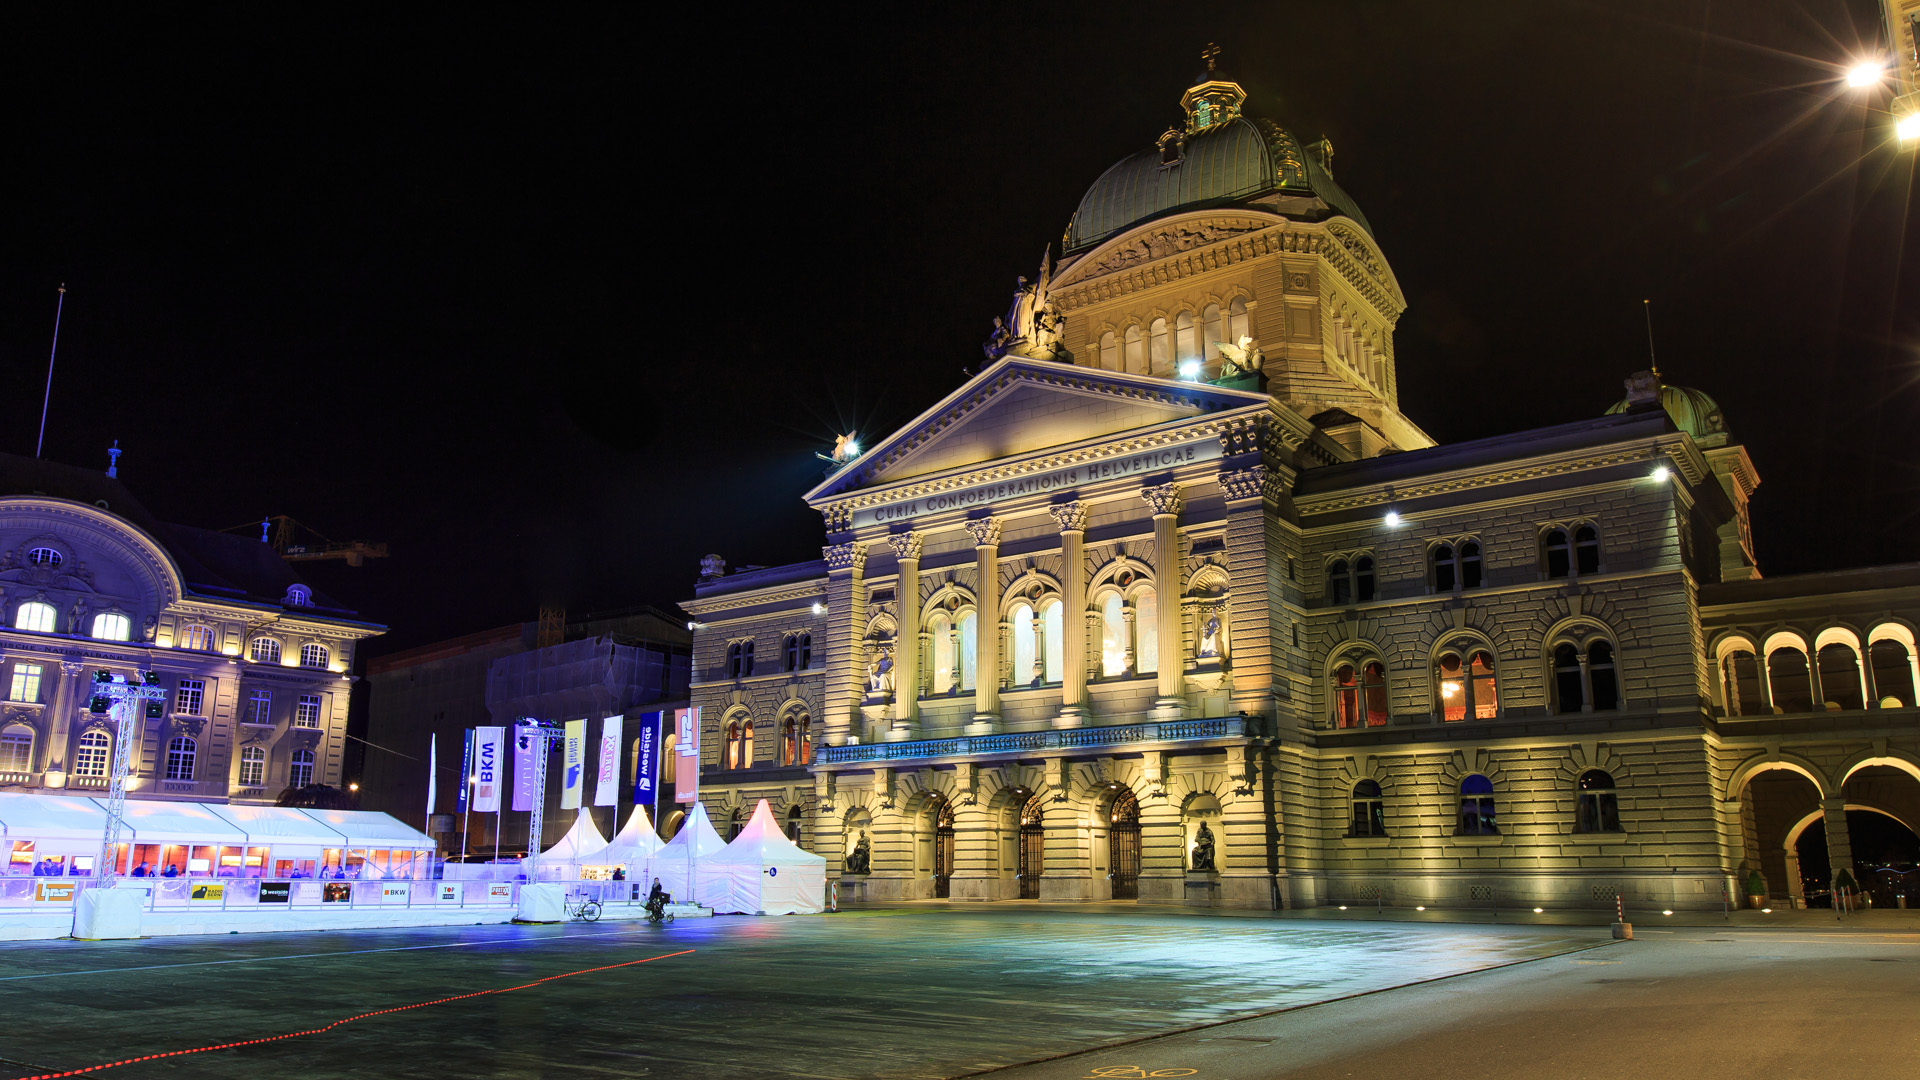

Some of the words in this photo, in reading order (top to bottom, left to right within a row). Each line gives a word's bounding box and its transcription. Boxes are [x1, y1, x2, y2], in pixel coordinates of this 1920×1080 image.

[874, 504, 918, 522] CURIA
[926, 472, 1078, 511] CONFOEDERATIONIS
[1088, 446, 1195, 480] HELVETICAE
[45, 646, 124, 661] NATIONALBANK
